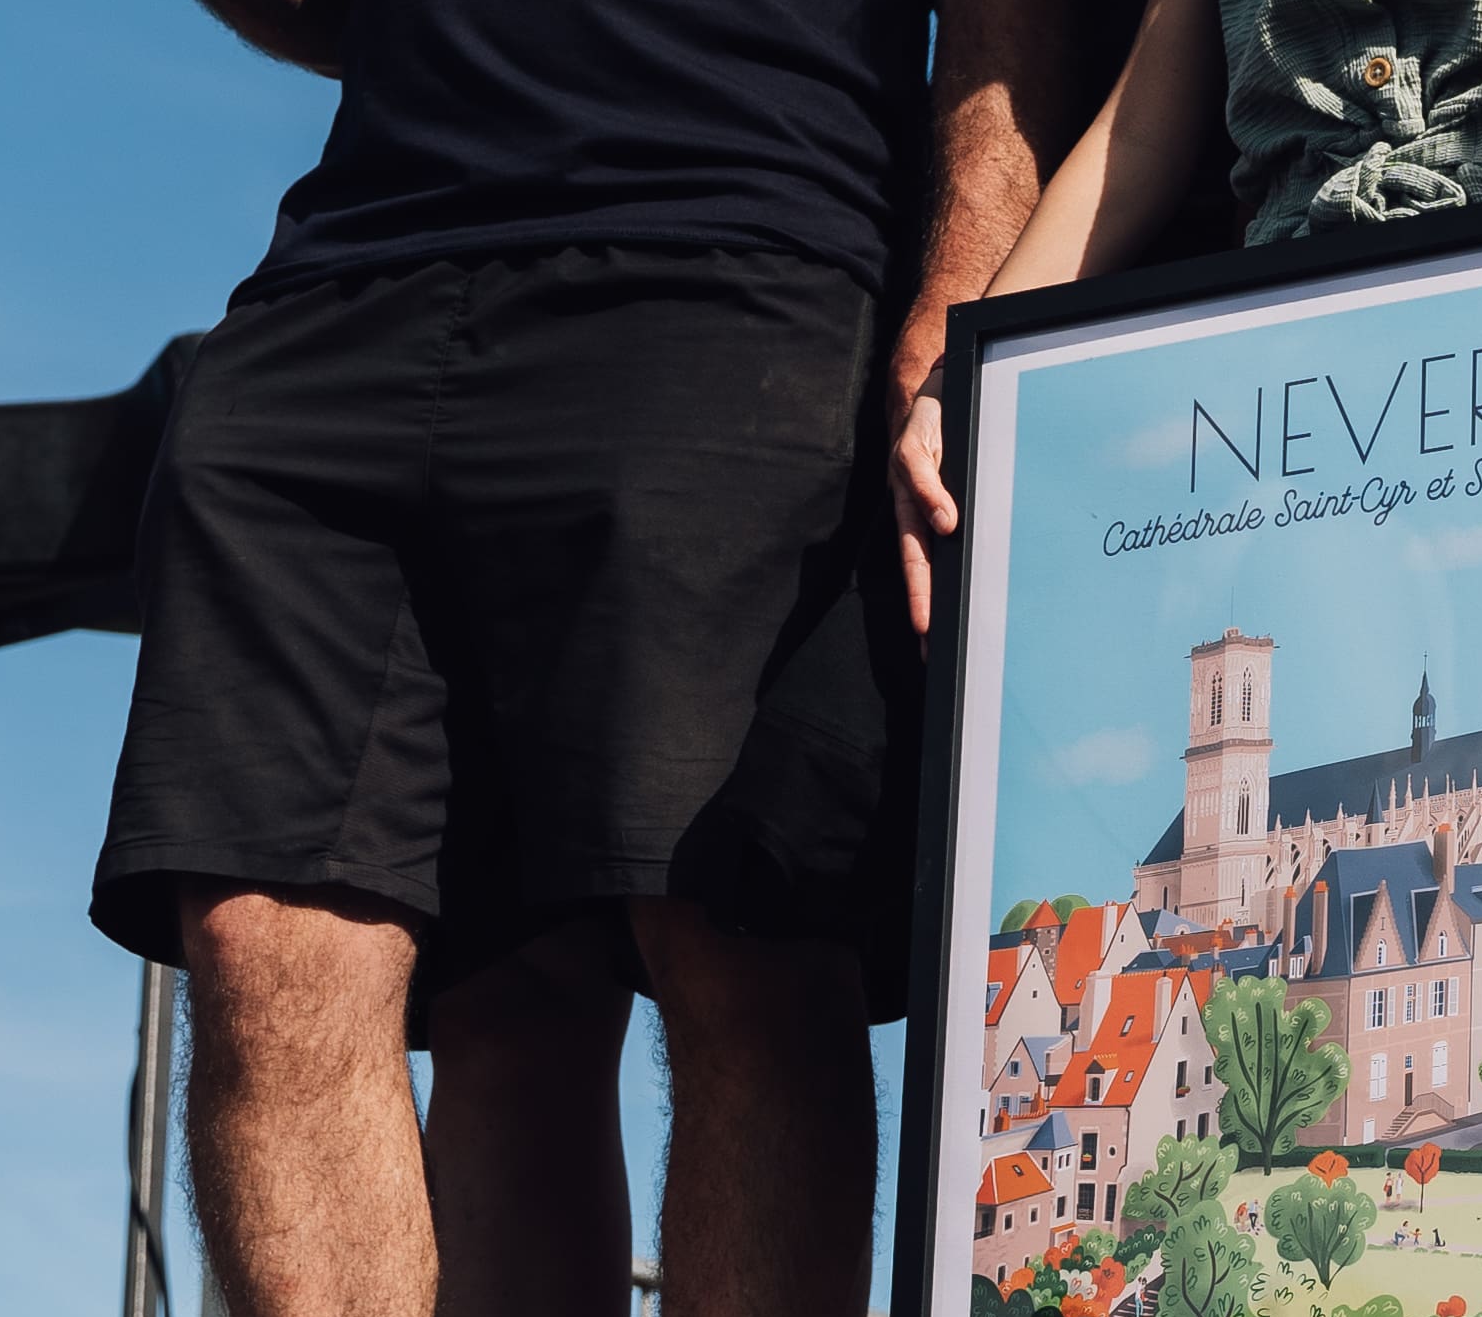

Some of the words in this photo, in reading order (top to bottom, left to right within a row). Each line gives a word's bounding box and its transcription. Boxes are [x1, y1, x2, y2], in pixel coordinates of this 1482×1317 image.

[1101, 499, 1266, 558] Cathédrale
[1273, 474, 1417, 530] Saint-Cyr
[1426, 468, 1455, 501] et
